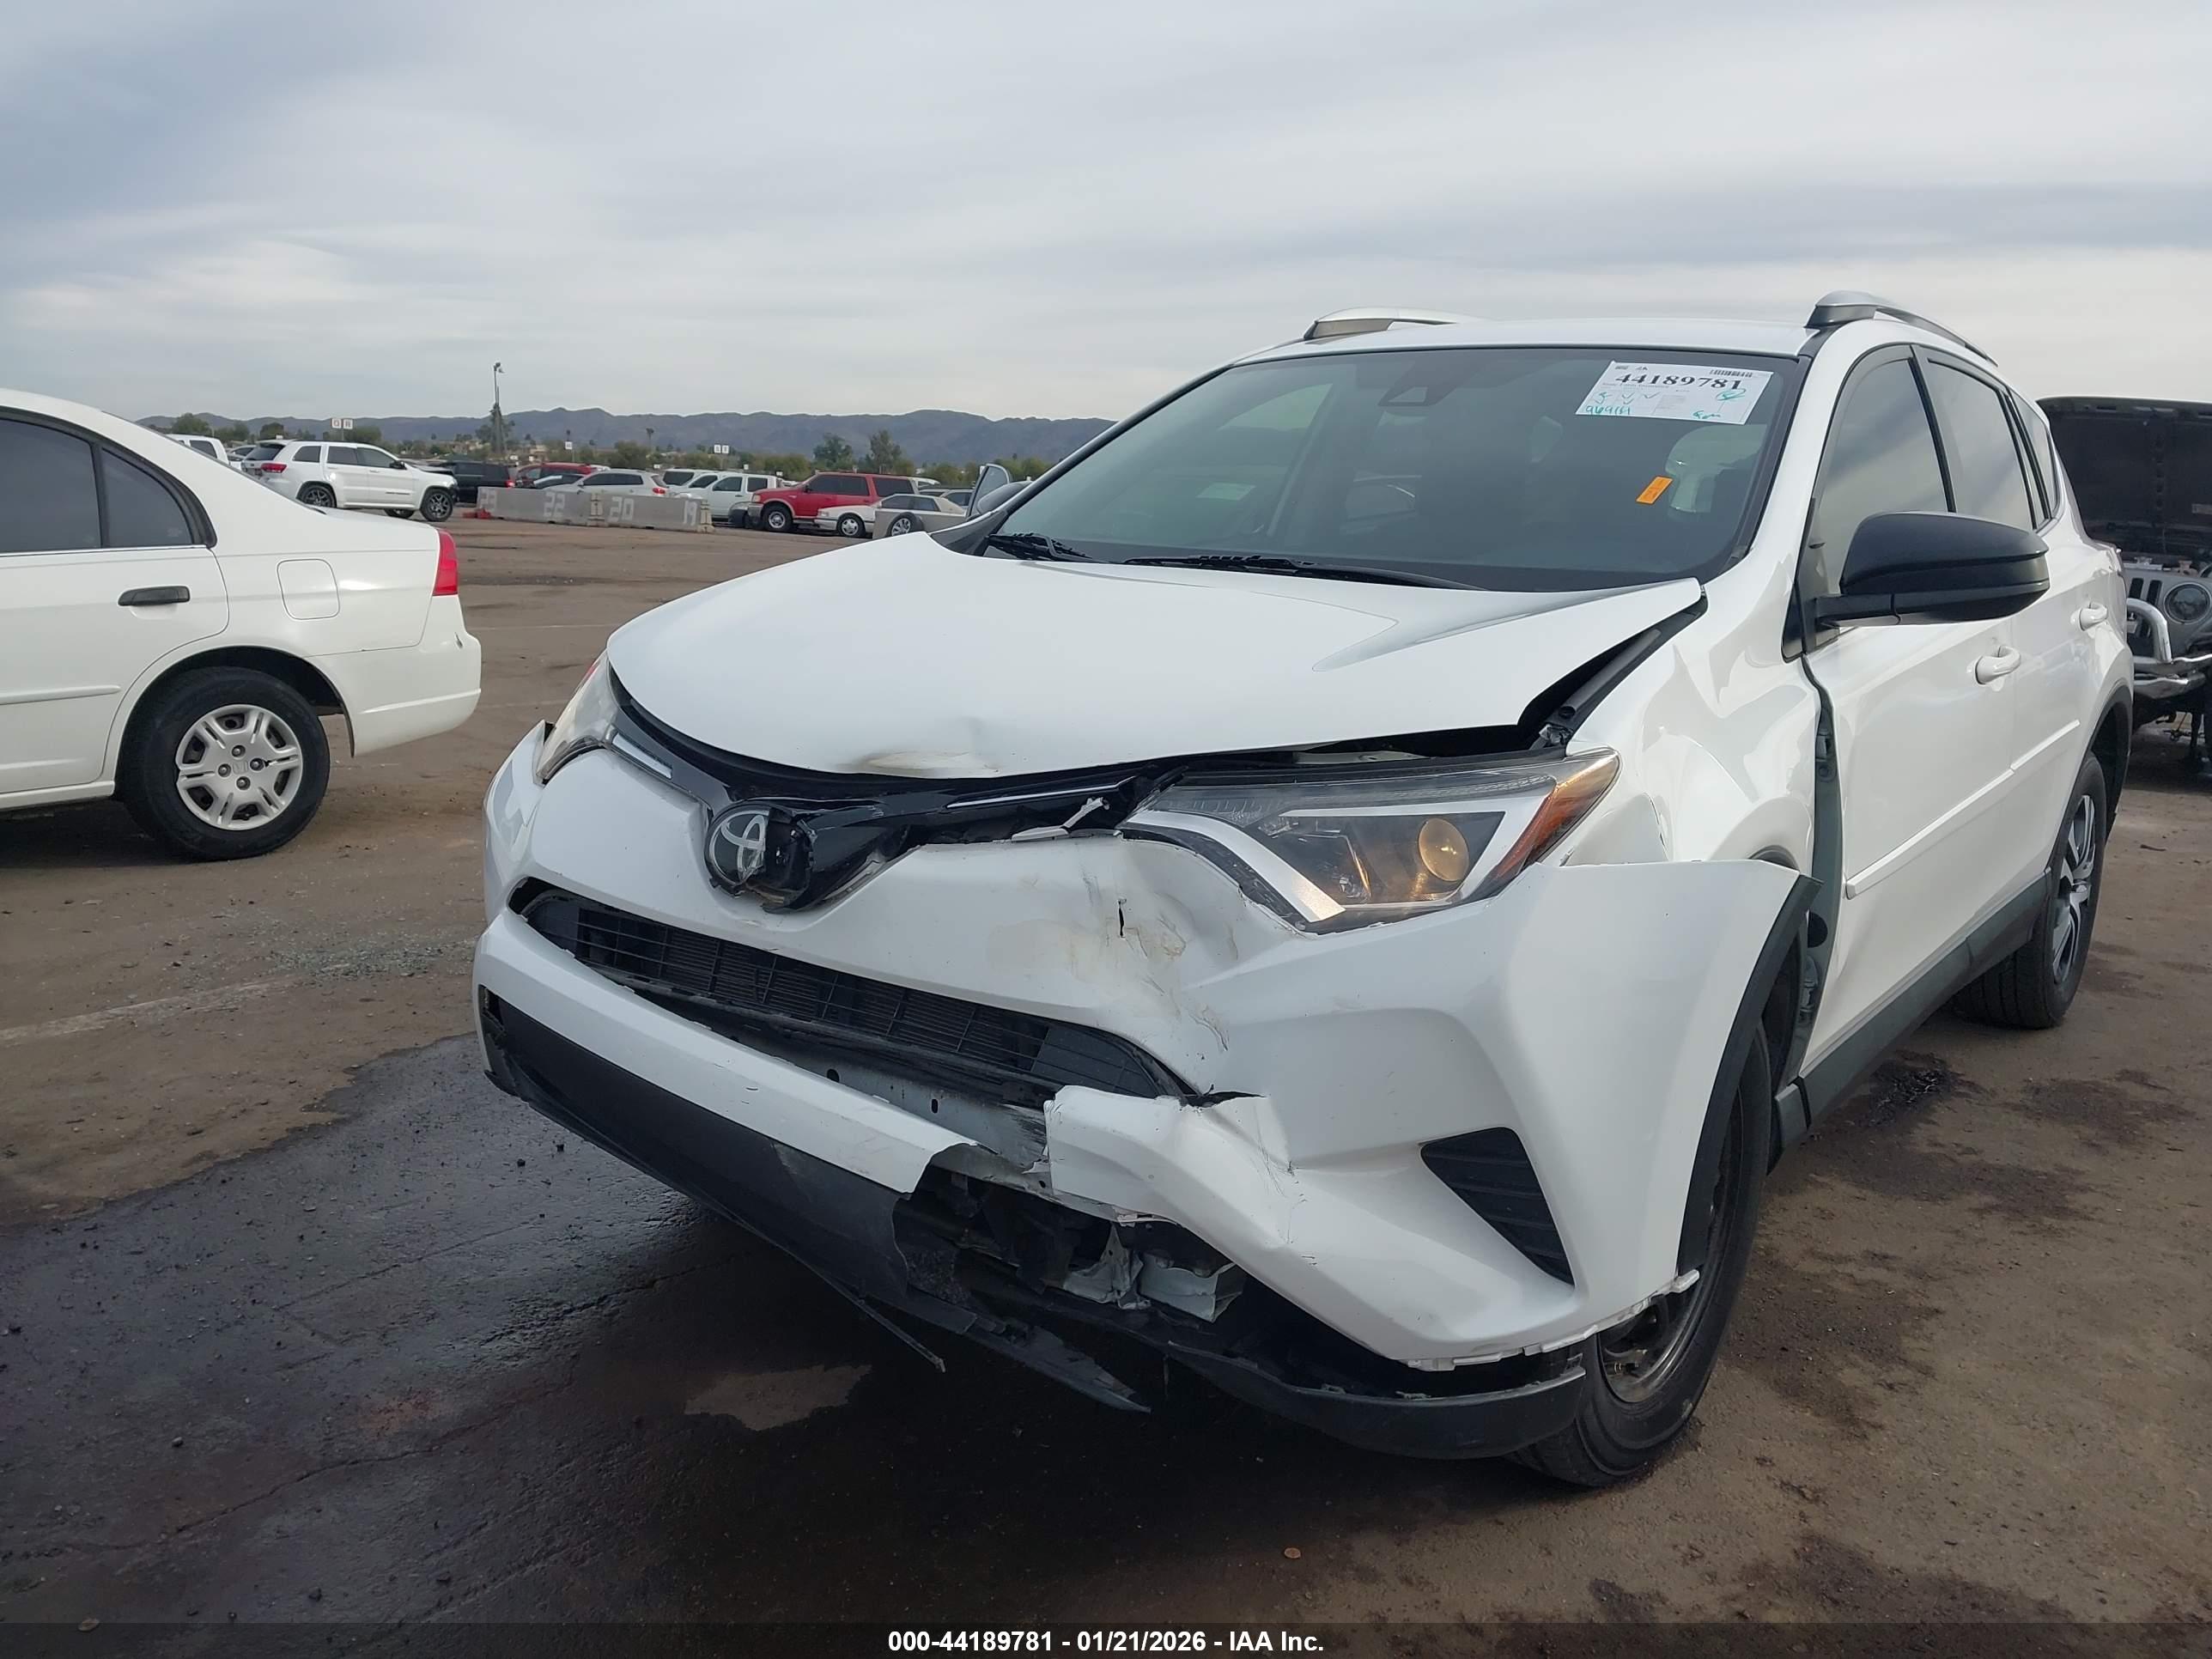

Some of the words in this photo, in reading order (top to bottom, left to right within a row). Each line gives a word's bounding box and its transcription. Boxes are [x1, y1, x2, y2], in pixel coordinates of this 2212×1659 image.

[1615, 373, 1742, 390] 44189781
[544, 491, 566, 518] 22
[608, 496, 635, 522] 20
[683, 500, 698, 526] 19
